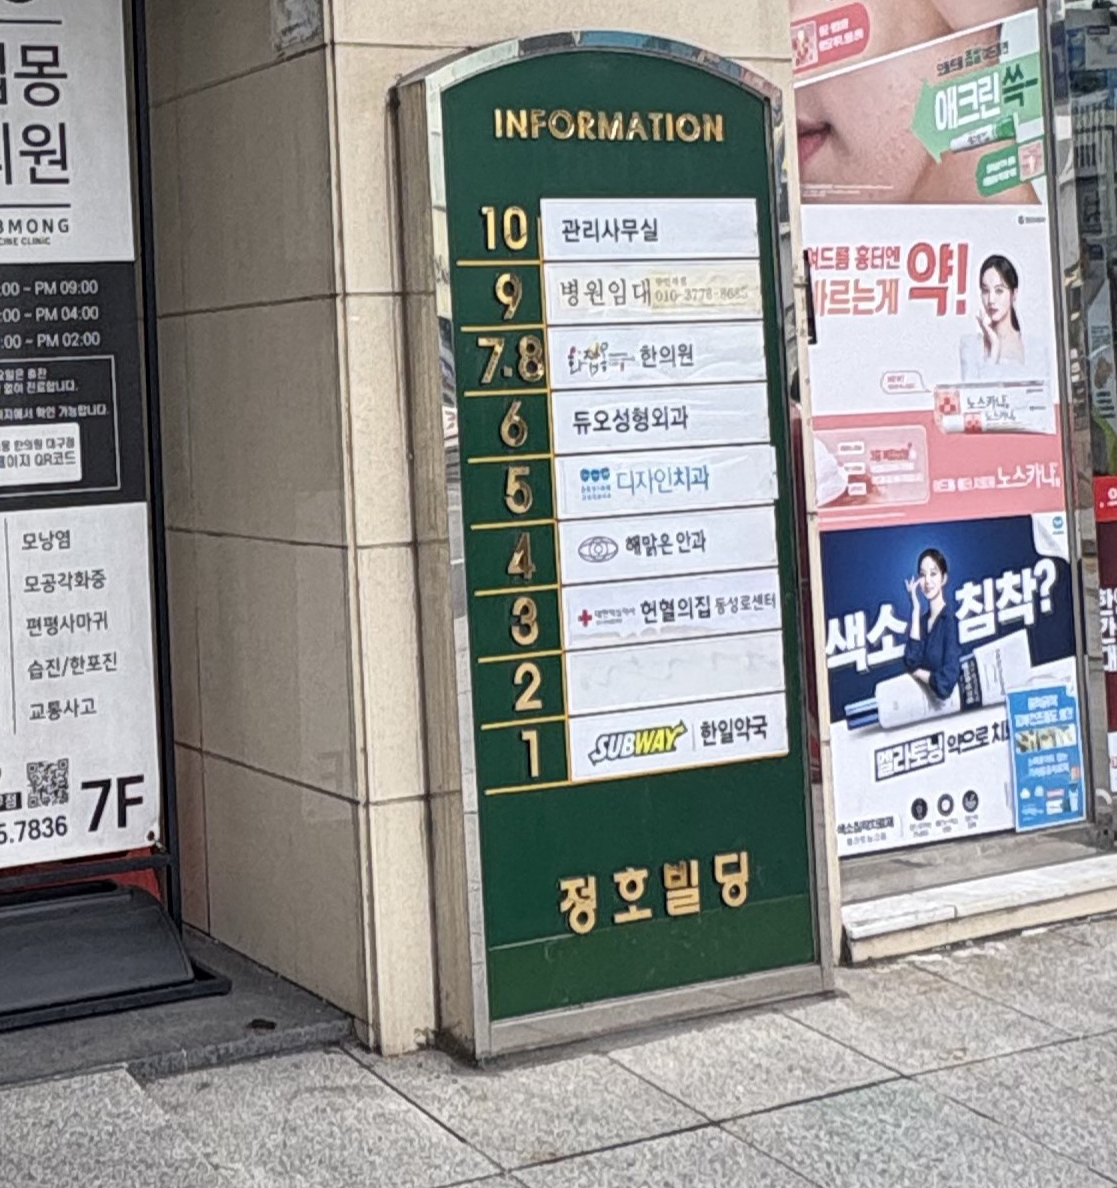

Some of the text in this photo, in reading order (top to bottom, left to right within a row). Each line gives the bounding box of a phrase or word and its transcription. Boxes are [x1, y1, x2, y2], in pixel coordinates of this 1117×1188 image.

[935, 72, 1001, 131] 애크린
[494, 108, 724, 142] INFORMATION
[21, 236, 51, 245] CLINIC
[481, 207, 528, 250] 10
[561, 218, 659, 243] 관리사무실
[855, 245, 901, 271] 흉터엔
[35, 281, 57, 296] PM
[60, 280, 98, 295] 09:00
[907, 242, 969, 316] 약!
[495, 273, 523, 320] 9
[36, 307, 58, 322] PM
[61, 306, 99, 321] 04:00
[37, 333, 59, 348] PM
[62, 332, 100, 347] 02:00
[639, 343, 695, 368] 한의원
[4, 382, 24, 396] 없이
[36, 407, 56, 420] 확인
[499, 400, 529, 448] 6
[572, 406, 688, 435] 듀오성형외과
[14, 439, 43, 451] 한의원
[46, 437, 75, 449] 대구점
[34, 451, 76, 467] QR코드
[504, 466, 533, 514] 5
[617, 466, 709, 495] 디자인치과
[22, 530, 72, 551] 모낭염
[507, 532, 535, 579] 4
[23, 568, 107, 594] 모공각화증
[511, 597, 538, 646] 3
[641, 595, 711, 624] 헌혈의집
[715, 592, 776, 616] 동성로센터
[825, 558, 1057, 673] 색소 침착?
[26, 611, 108, 637] 편평사마귀
[27, 652, 117, 681] 습진/한포진
[514, 662, 542, 711] 2
[29, 698, 98, 722] 교통사고
[588, 720, 687, 766] SUBWAY
[700, 716, 768, 747] 한일약국
[521, 730, 539, 778] 1
[877, 733, 943, 779] 멜라토닝
[947, 725, 989, 754] 약으로
[81, 774, 145, 833] 7F
[559, 851, 750, 935] 정호빌딩
